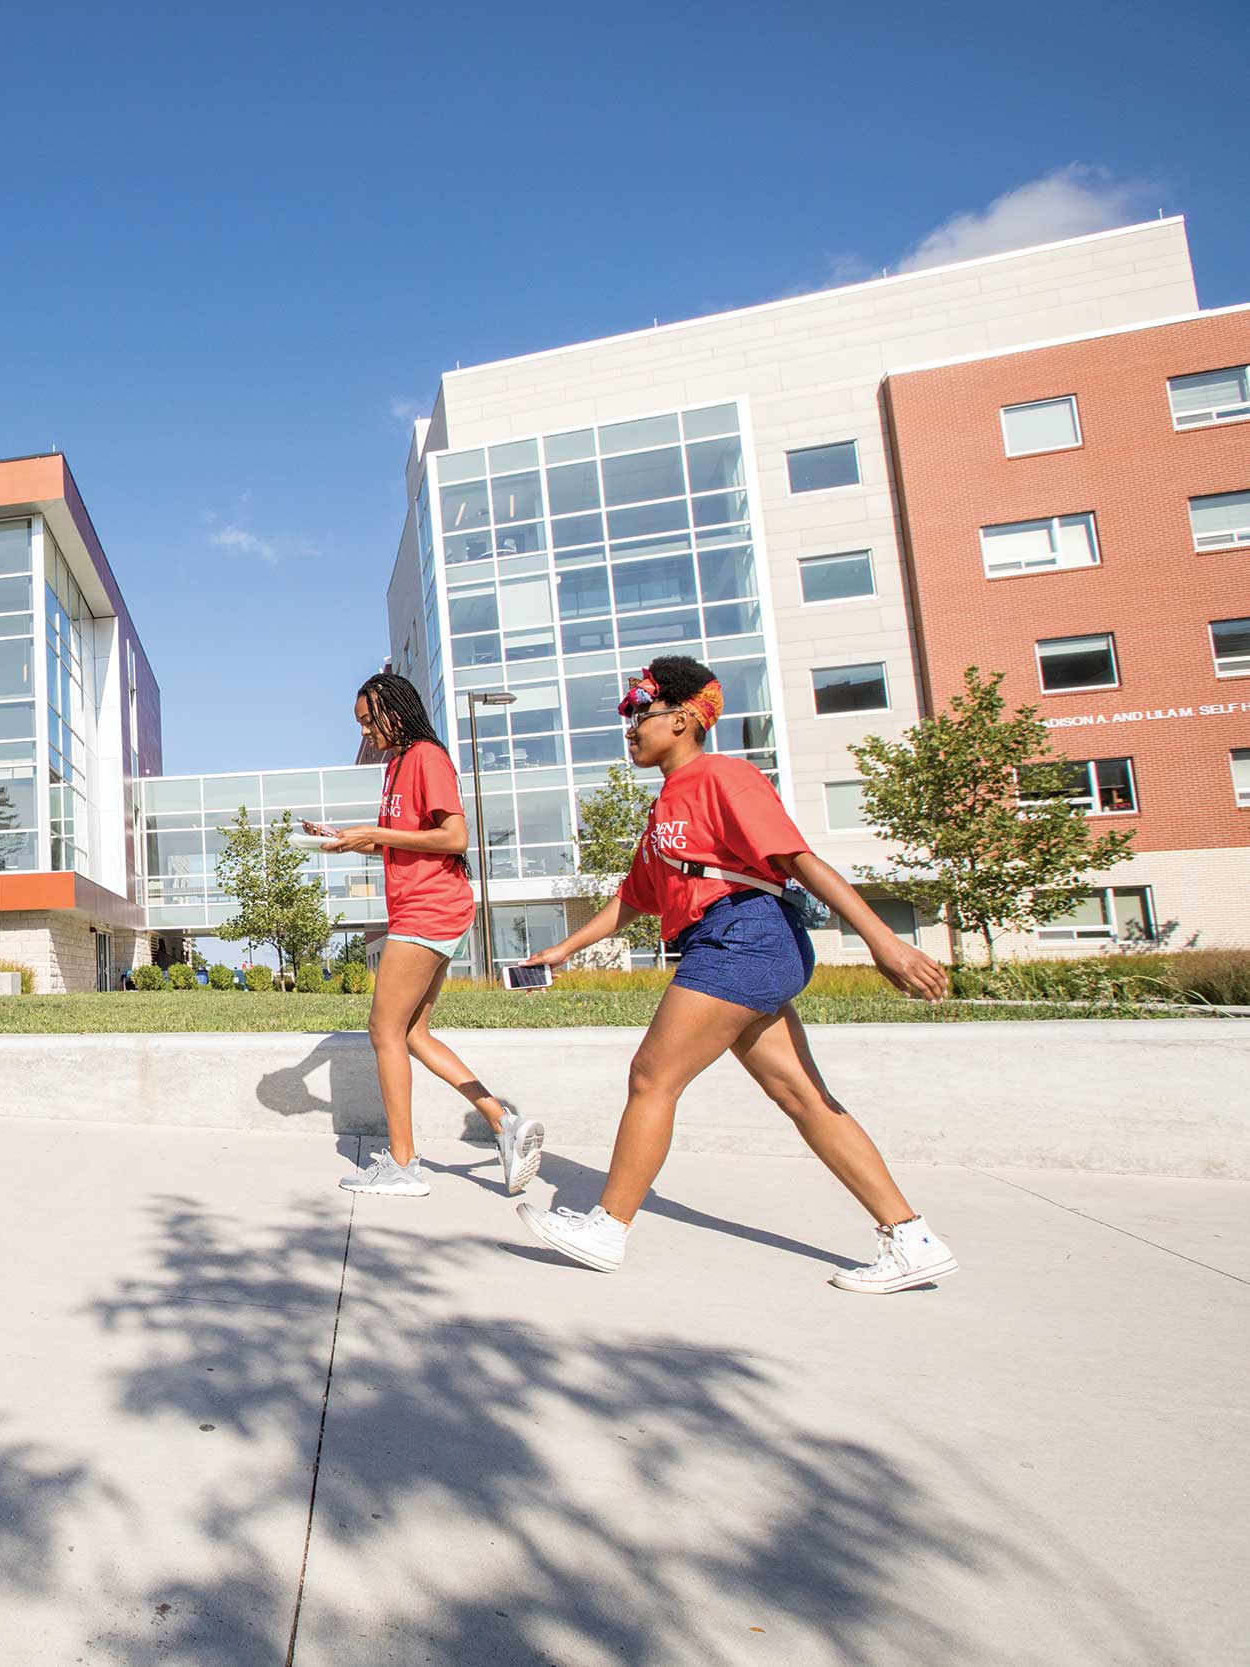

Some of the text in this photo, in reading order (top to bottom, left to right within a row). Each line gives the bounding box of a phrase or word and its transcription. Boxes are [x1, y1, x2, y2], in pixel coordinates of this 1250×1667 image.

[1112, 711, 1143, 723] AND
[1146, 708, 1177, 720] LILA
[1199, 702, 1239, 716] SELF
